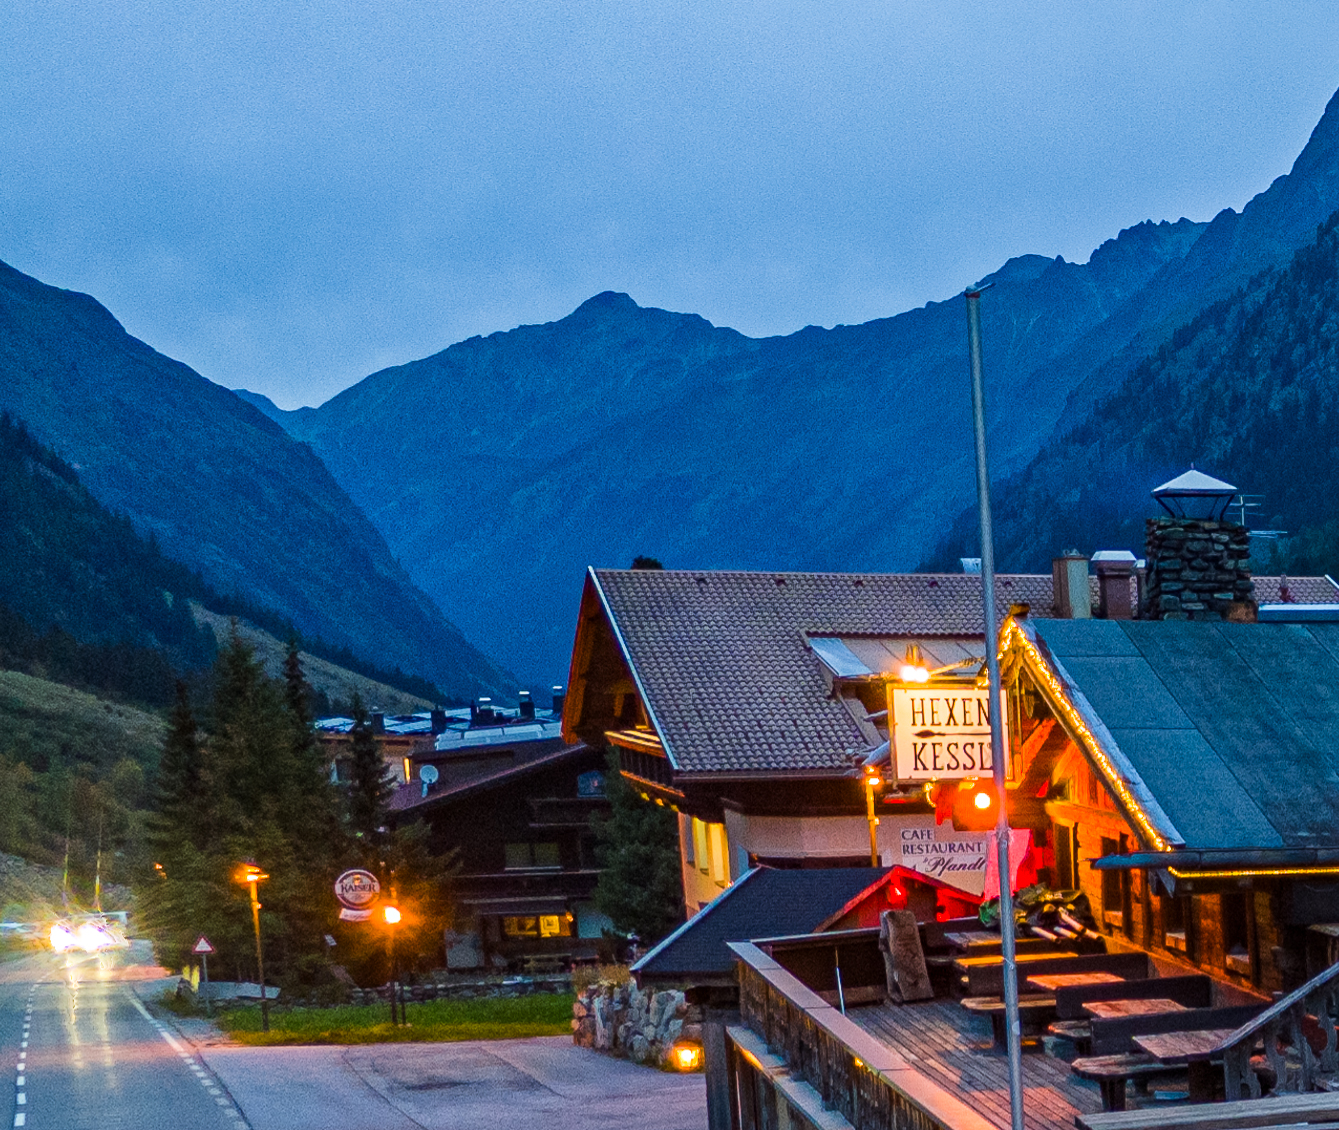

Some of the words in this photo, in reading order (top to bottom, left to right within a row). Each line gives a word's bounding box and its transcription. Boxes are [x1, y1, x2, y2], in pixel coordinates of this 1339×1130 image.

[910, 697, 991, 727] HEXEN
[901, 829, 933, 840] CAFE
[902, 842, 983, 855] RESTAURANT
